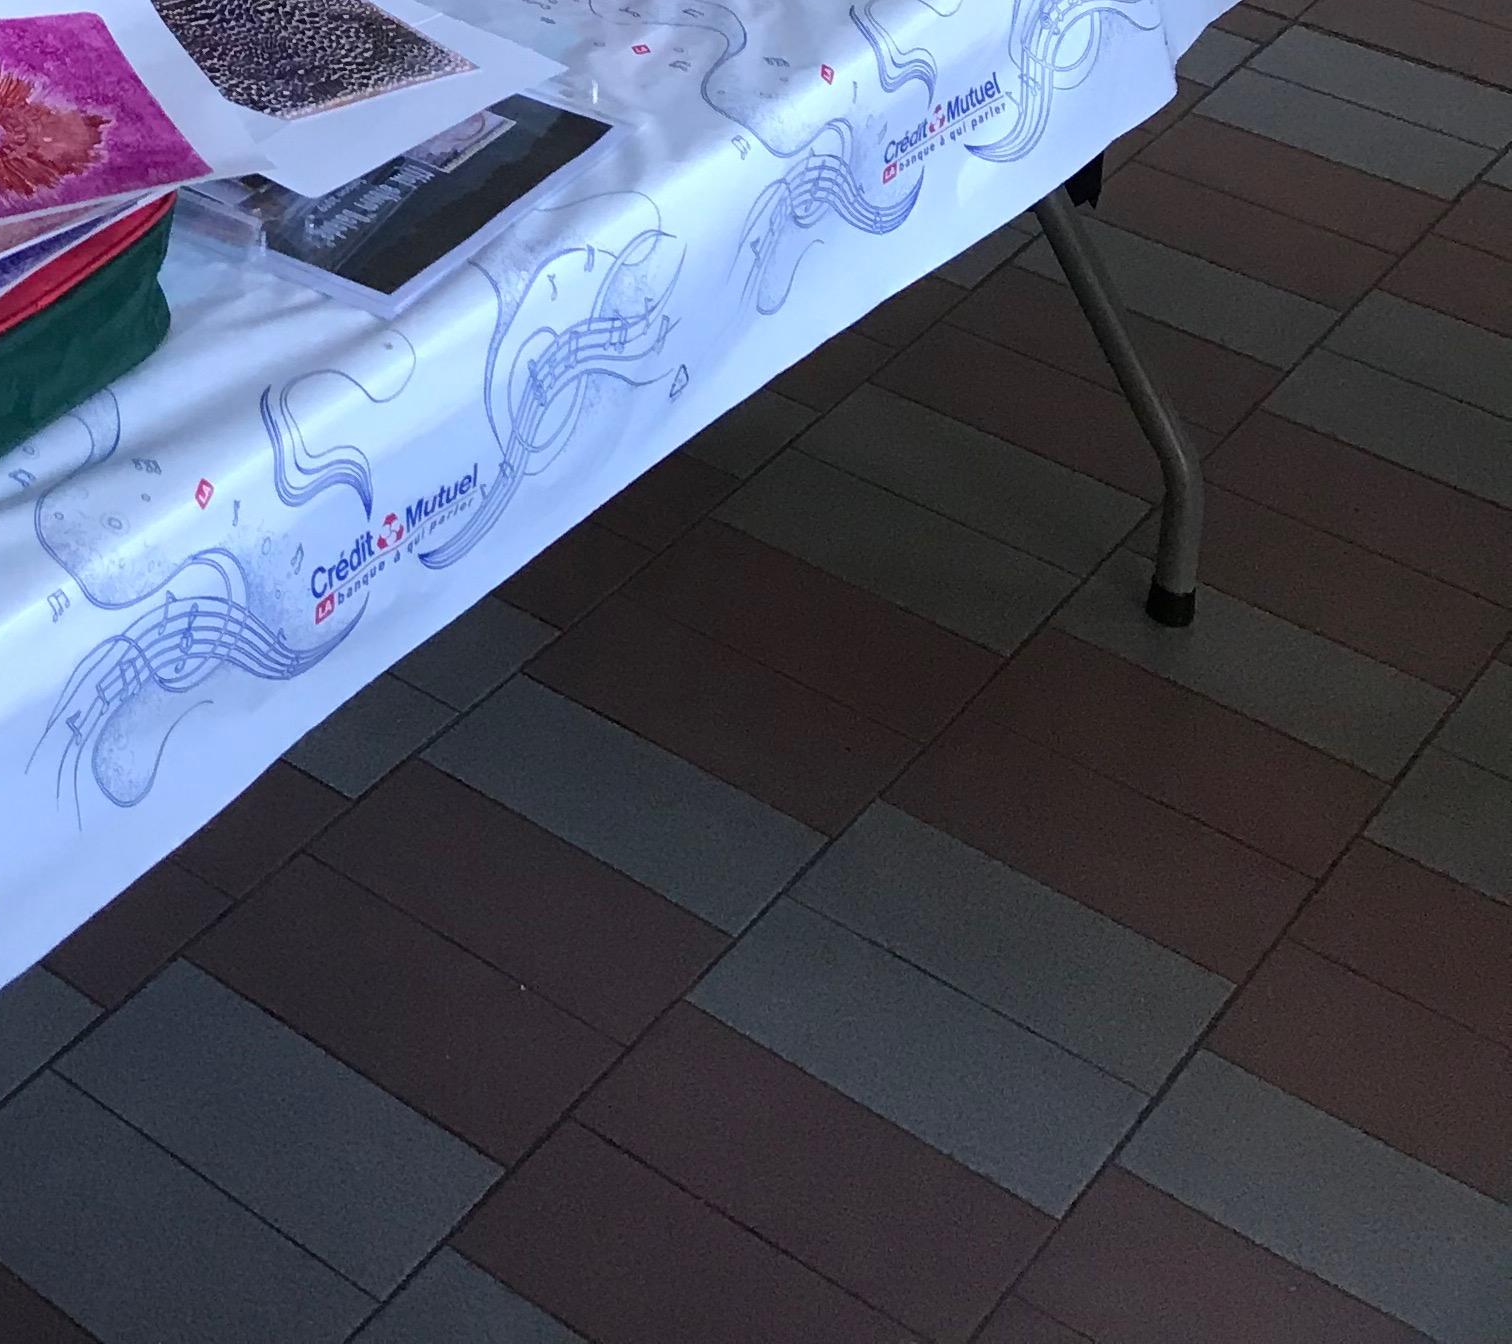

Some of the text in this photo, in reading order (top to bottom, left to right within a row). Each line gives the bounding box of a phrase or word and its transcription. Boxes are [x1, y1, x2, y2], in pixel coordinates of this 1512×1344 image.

[884, 71, 1001, 164] Crédit Mutuel
[898, 140, 936, 172] banque
[949, 122, 968, 142] qui
[971, 102, 1007, 131] parler
[310, 463, 479, 599] Crédit Mutuel
[337, 559, 386, 606] banque
[393, 552, 401, 564] à
[406, 531, 428, 555] qui
[428, 497, 475, 535] parler
